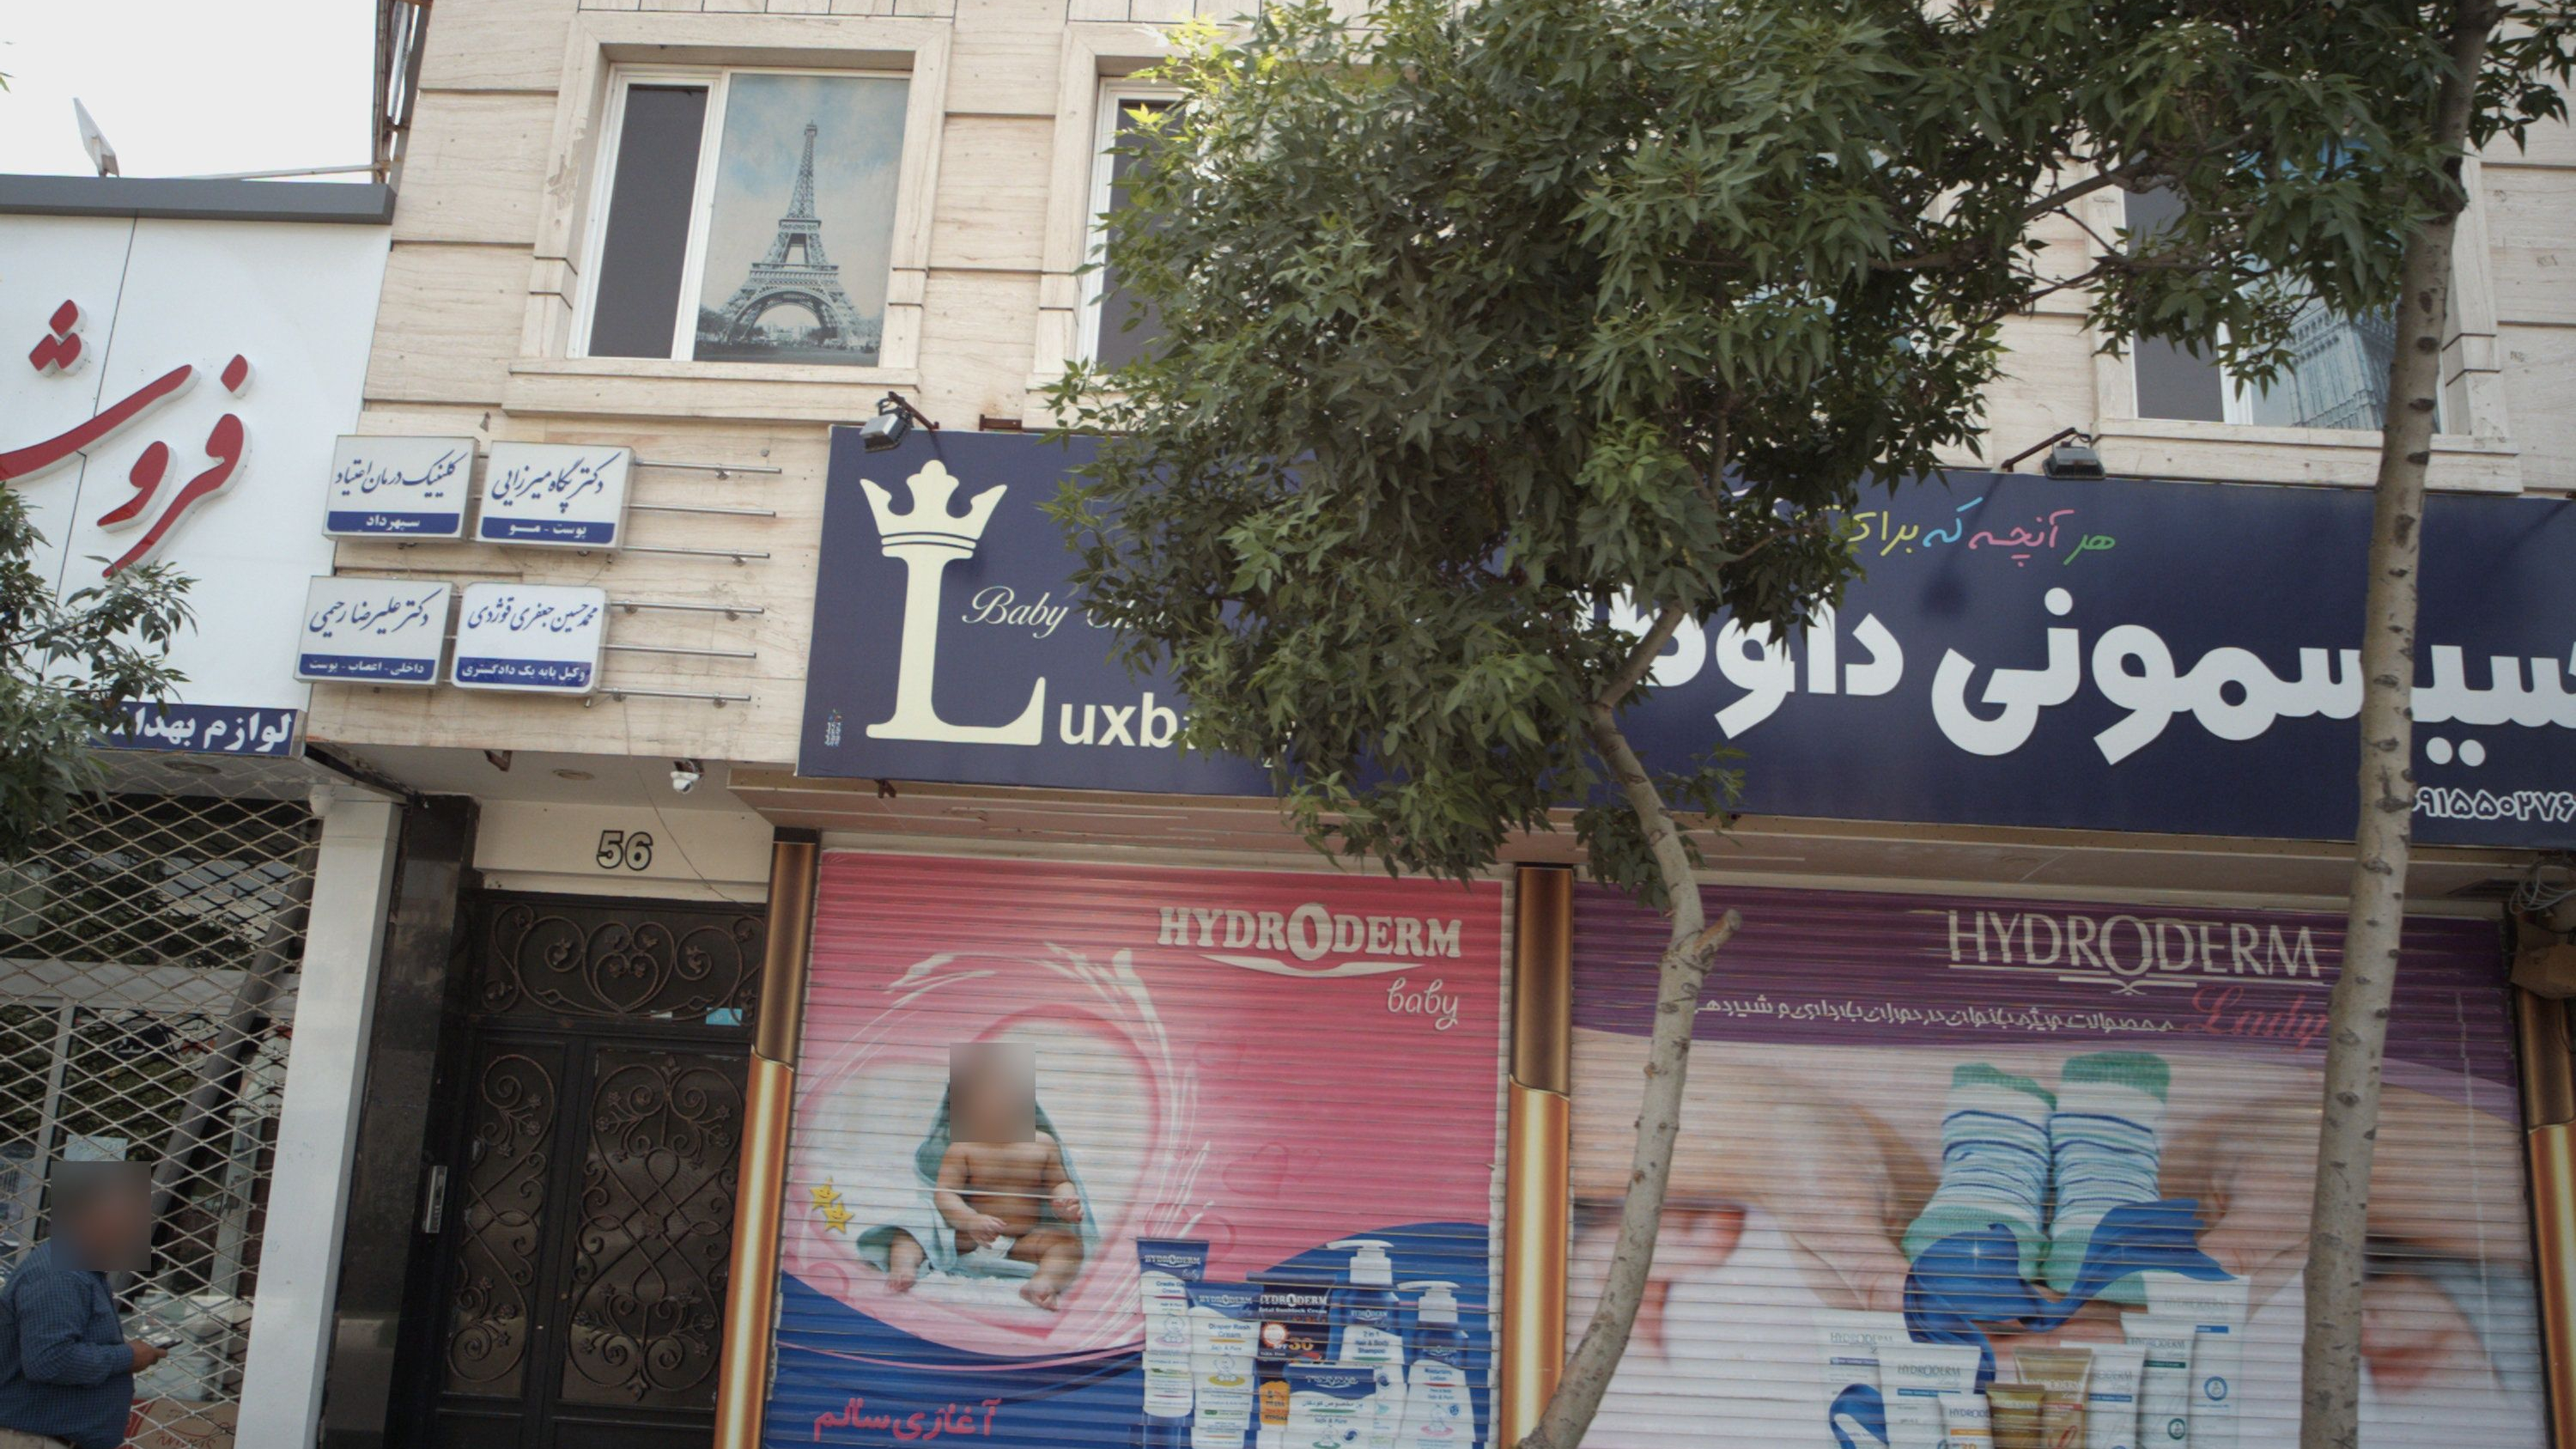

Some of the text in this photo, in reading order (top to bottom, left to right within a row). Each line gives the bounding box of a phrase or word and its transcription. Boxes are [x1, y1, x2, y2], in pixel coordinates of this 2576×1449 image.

[336, 450, 468, 498] کلینیک درمان اعتیاد
[491, 453, 622, 513] دکتر پگاه میرزایی
[553, 524, 587, 539] پوست
[1922, 496, 1984, 548] که
[1968, 508, 2075, 567] آنچه
[2063, 534, 2116, 565] هر
[309, 588, 443, 638] دکتر علیرضا رحیمی
[510, 603, 555, 630] جعفری
[962, 586, 1069, 639] Baby
[309, 659, 338, 673] پوست
[349, 661, 382, 673] اعصاب
[391, 661, 424, 676] داخلی
[462, 662, 586, 682] وکیل پایه یک دادگستری
[1932, 587, 2576, 767] سیسمونی
[204, 712, 291, 752] لوازم
[2412, 786, 2576, 823] ۹۱۵۵۰۲۷۶
[596, 830, 653, 871] 56
[1157, 903, 1463, 961] HYDRODERM
[1948, 910, 2320, 977] HYDRODERM
[1387, 977, 1460, 1032] baby
[1694, 994, 1773, 1017] شیرده
[1777, 1002, 1790, 1019] و
[1790, 999, 1863, 1022] بارداری
[1863, 1002, 1923, 1025] دوران
[1946, 1006, 2013, 1029] بانوان
[2183, 986, 2333, 1054] Lady
[814, 1397, 1003, 1442] آغازی سالم
